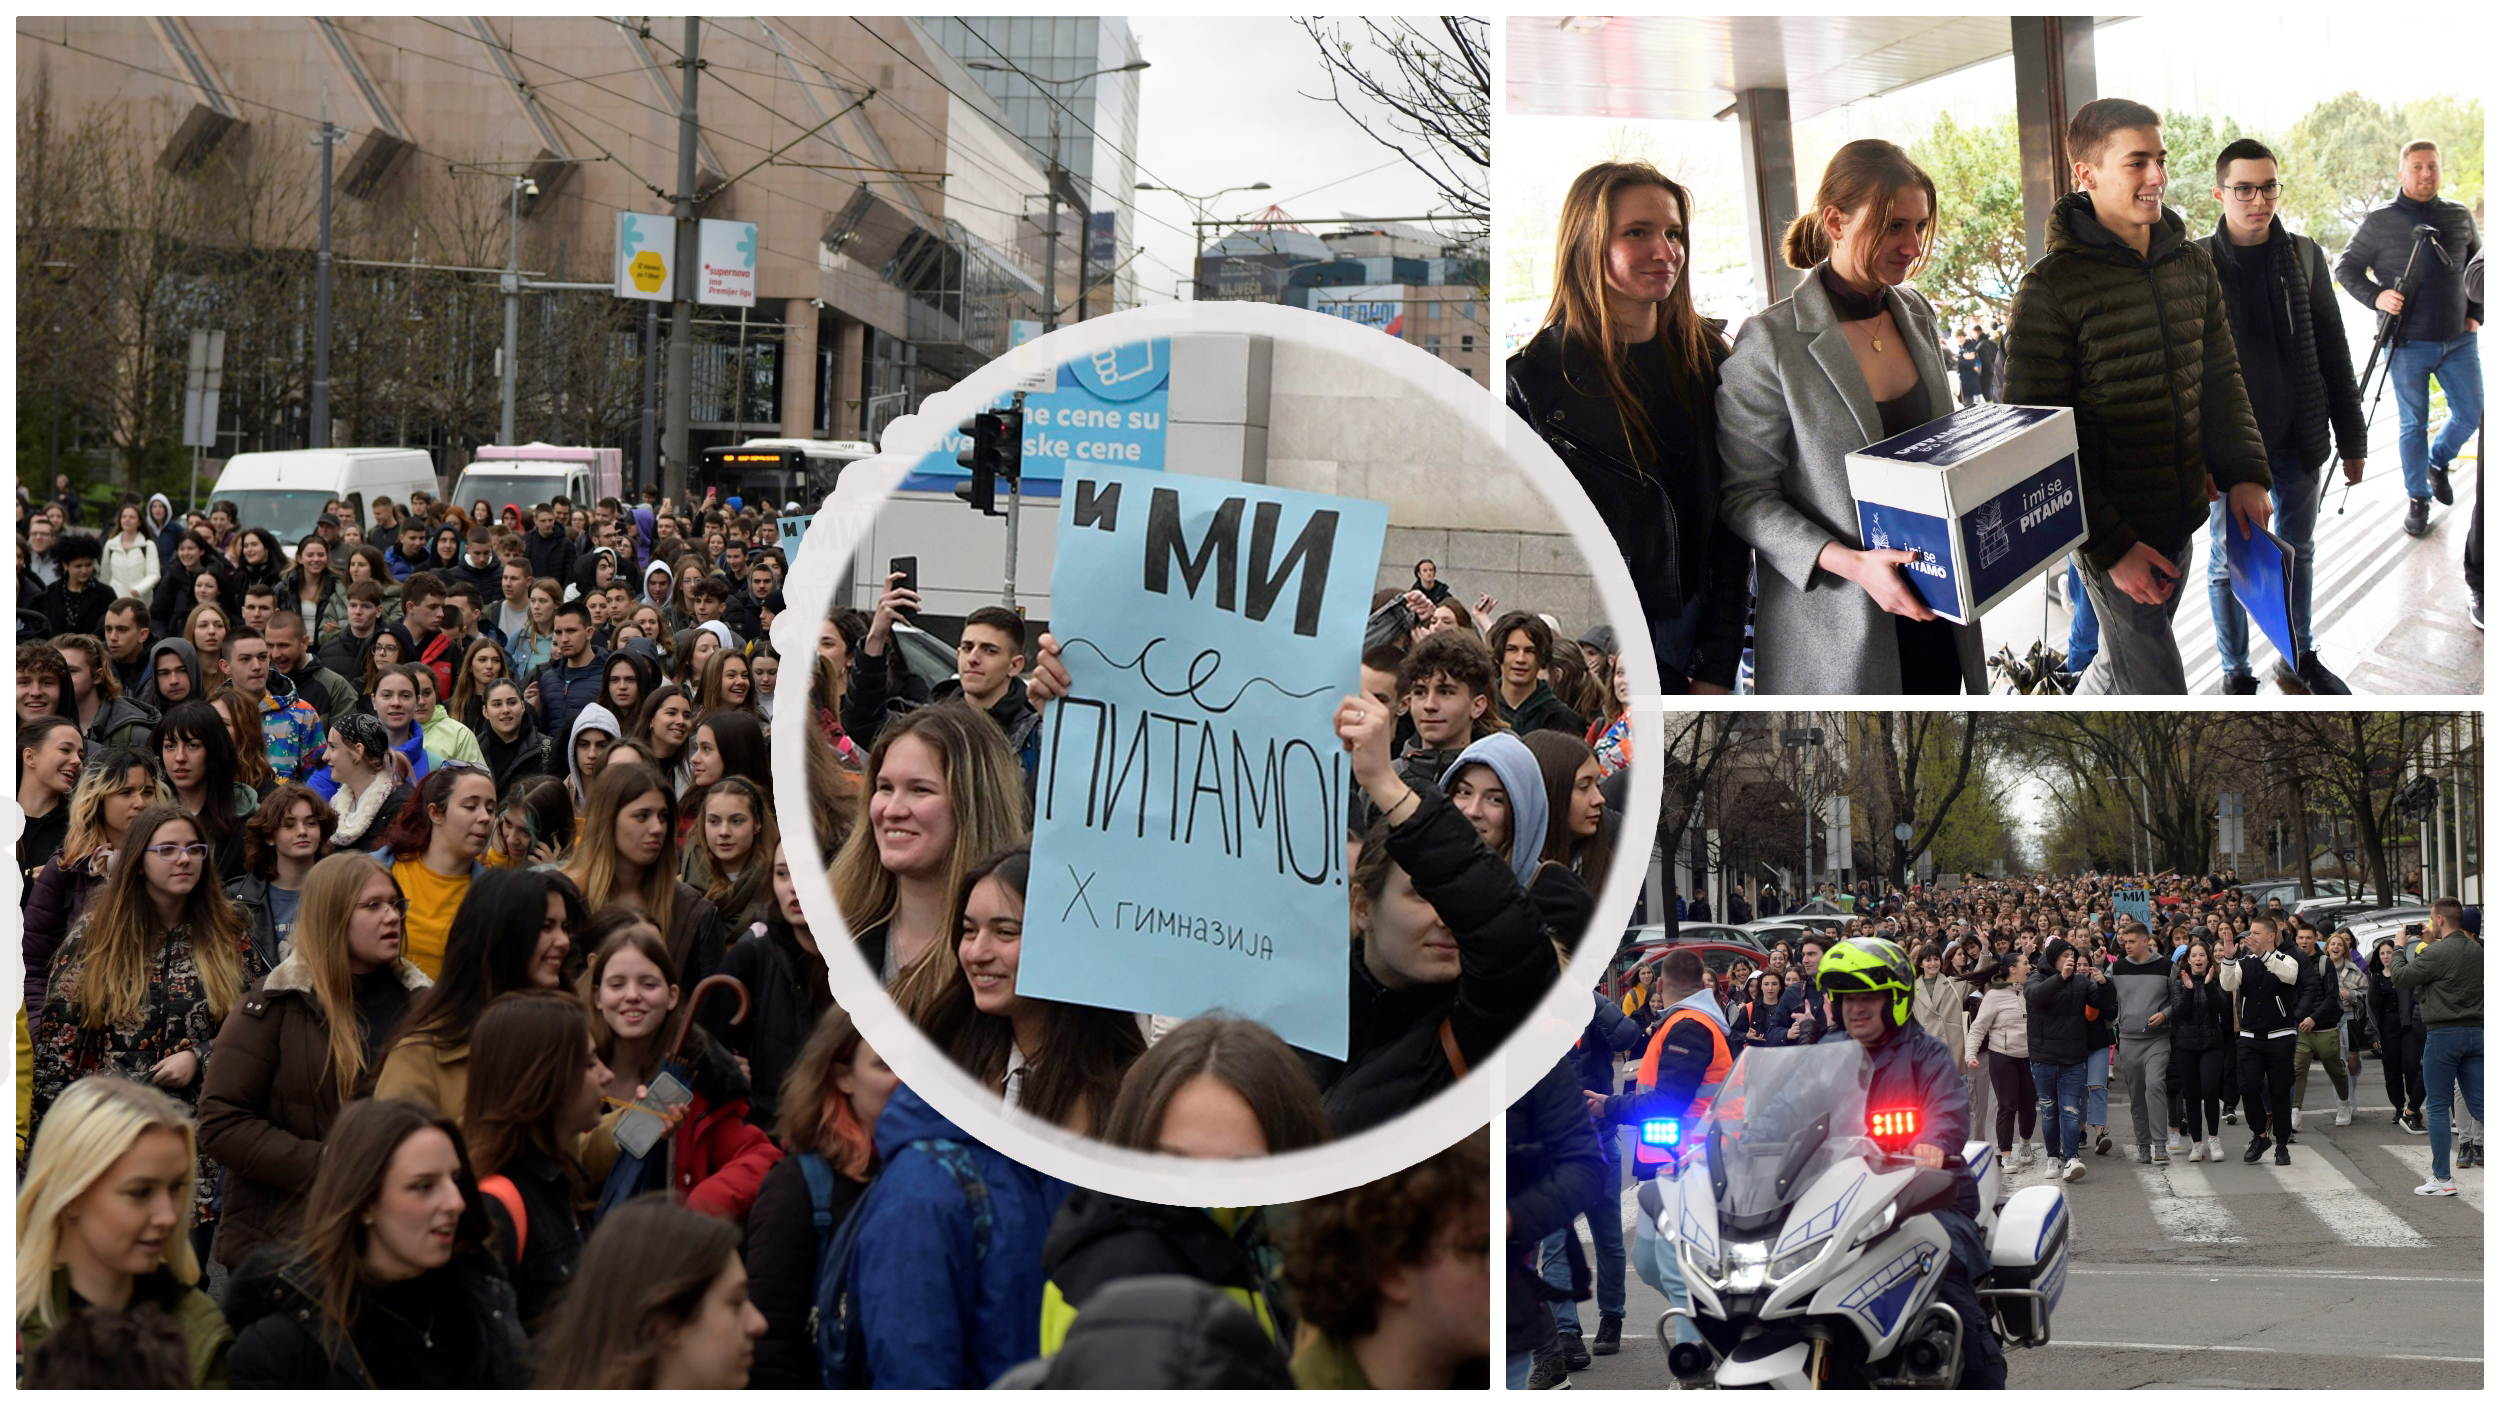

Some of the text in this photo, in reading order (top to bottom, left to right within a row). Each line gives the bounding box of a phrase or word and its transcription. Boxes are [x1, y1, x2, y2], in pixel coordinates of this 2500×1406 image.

[709, 278, 722, 286] ima
[709, 286, 752, 298] Premijer ligu
[1057, 408, 1121, 429] cene
[1127, 410, 1160, 430] su
[1076, 440, 1141, 461] cene
[2022, 478, 2063, 511] i mi se
[2020, 489, 2073, 534] PITAMO
[1143, 487, 1341, 638] МИ
[1923, 551, 1937, 564] se
[1904, 559, 1947, 579] ITAMO
[1045, 695, 1343, 886] ПИТАМО!
[2122, 890, 2145, 902] МИ
